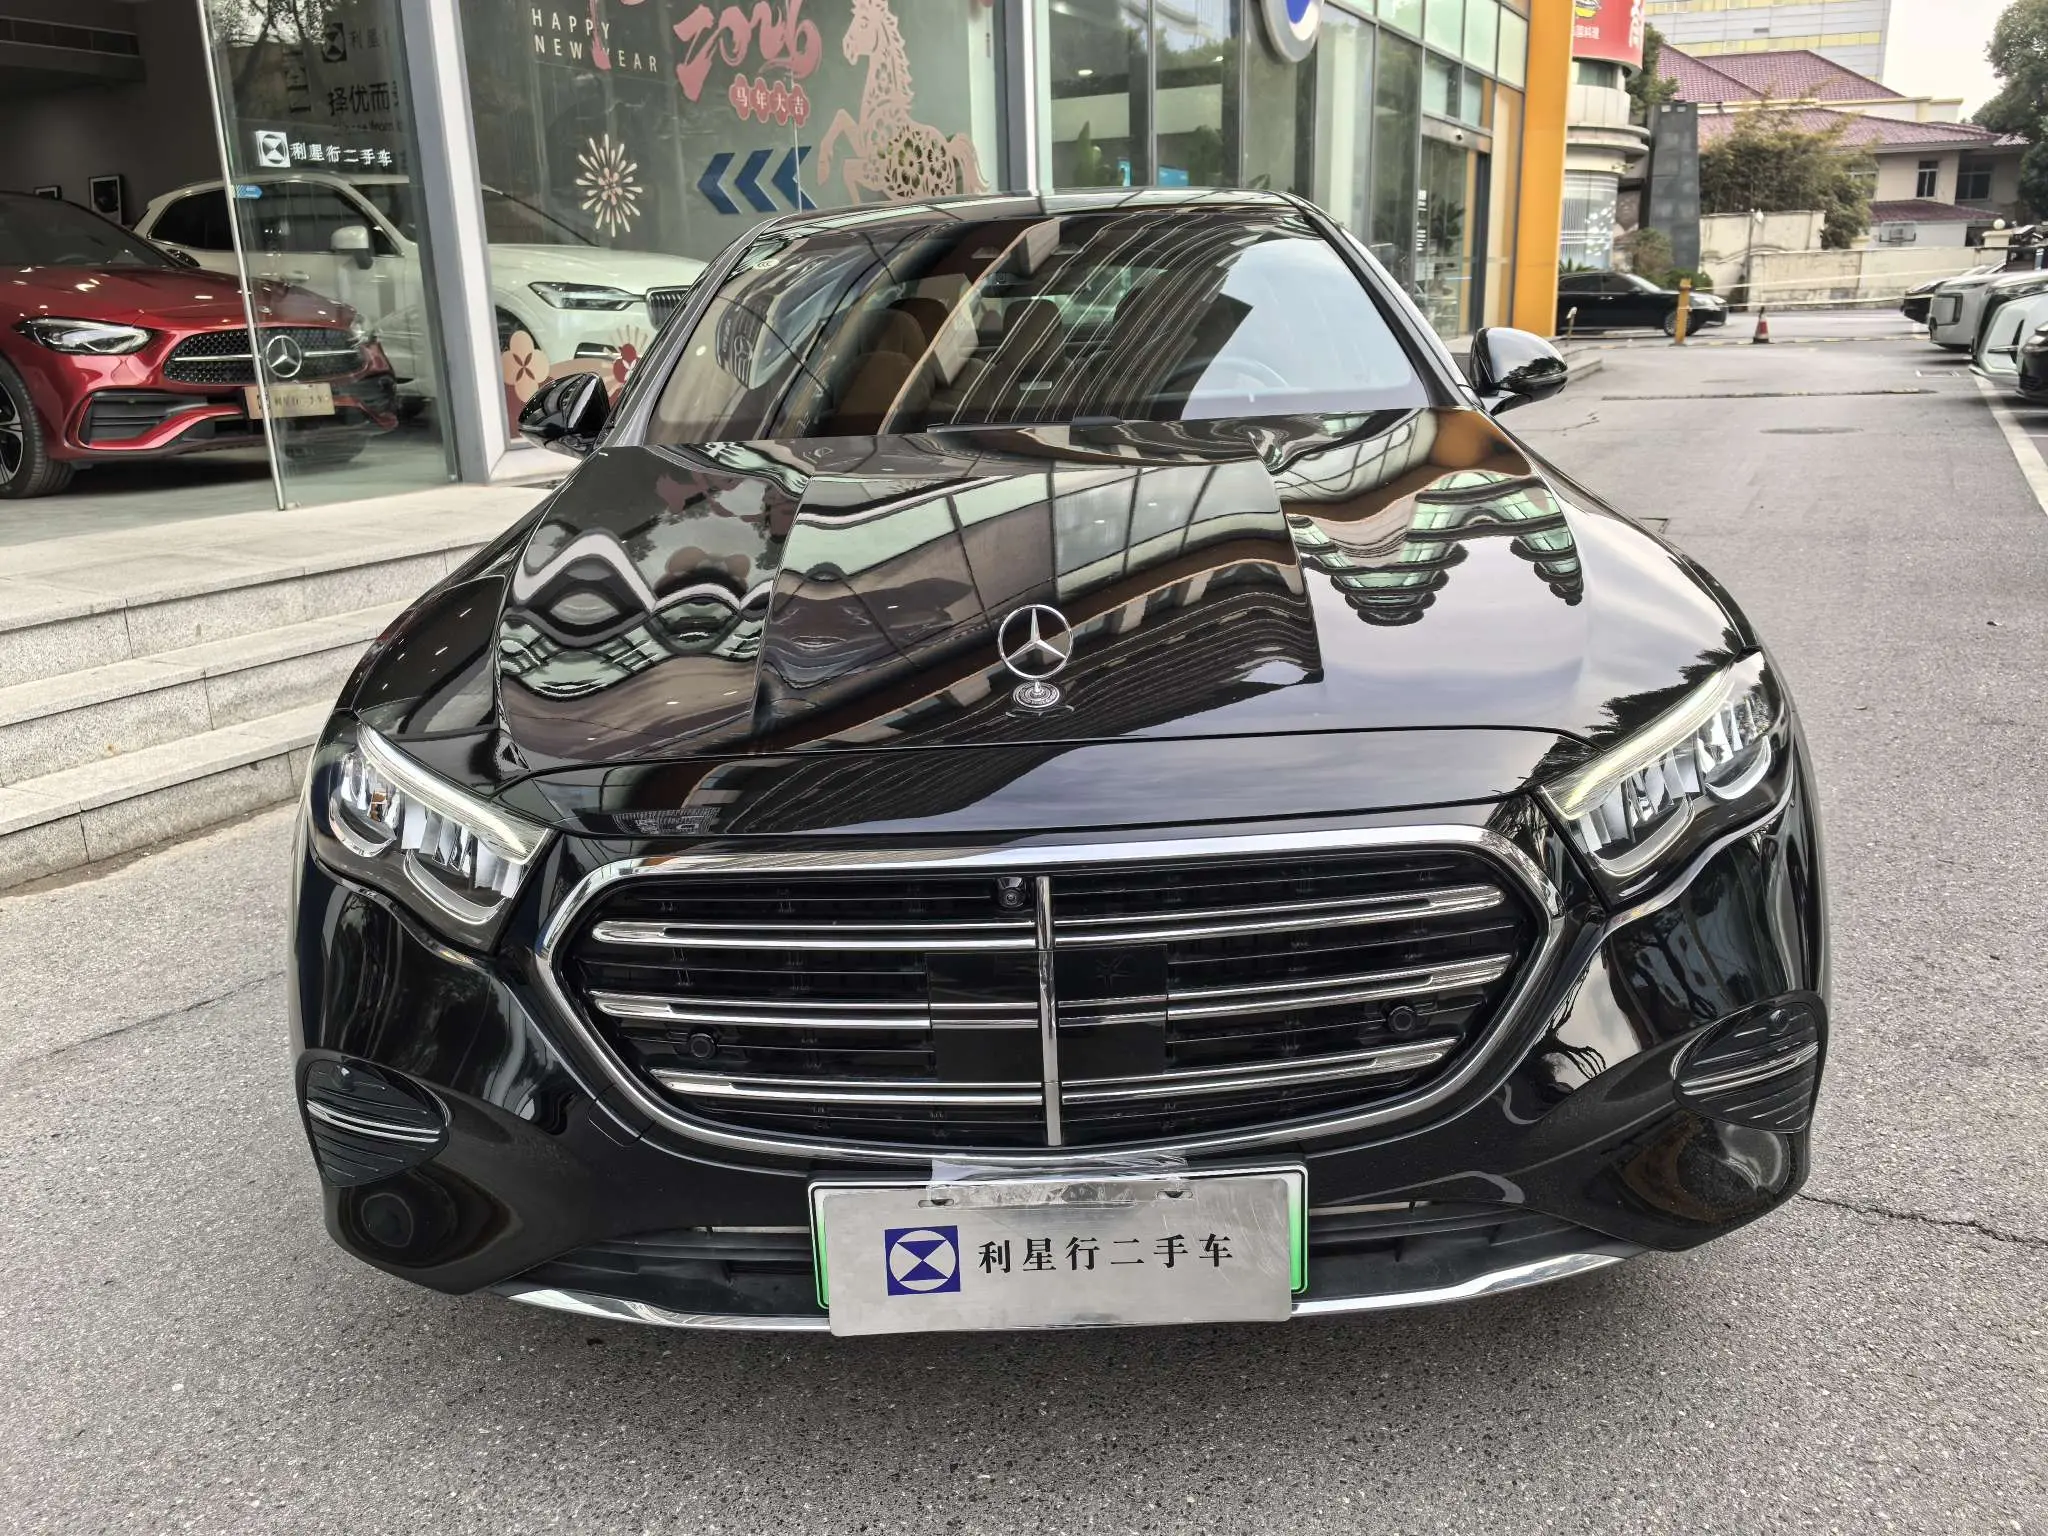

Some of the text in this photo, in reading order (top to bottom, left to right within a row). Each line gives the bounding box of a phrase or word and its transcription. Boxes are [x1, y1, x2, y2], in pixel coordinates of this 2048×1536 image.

[531, 8, 609, 39] HAPPY
[534, 34, 583, 60] NEW
[736, 87, 804, 115] 马年大吉
[289, 142, 393, 167] 利星行二手车
[978, 1233, 1233, 1274] 利星行二手车
